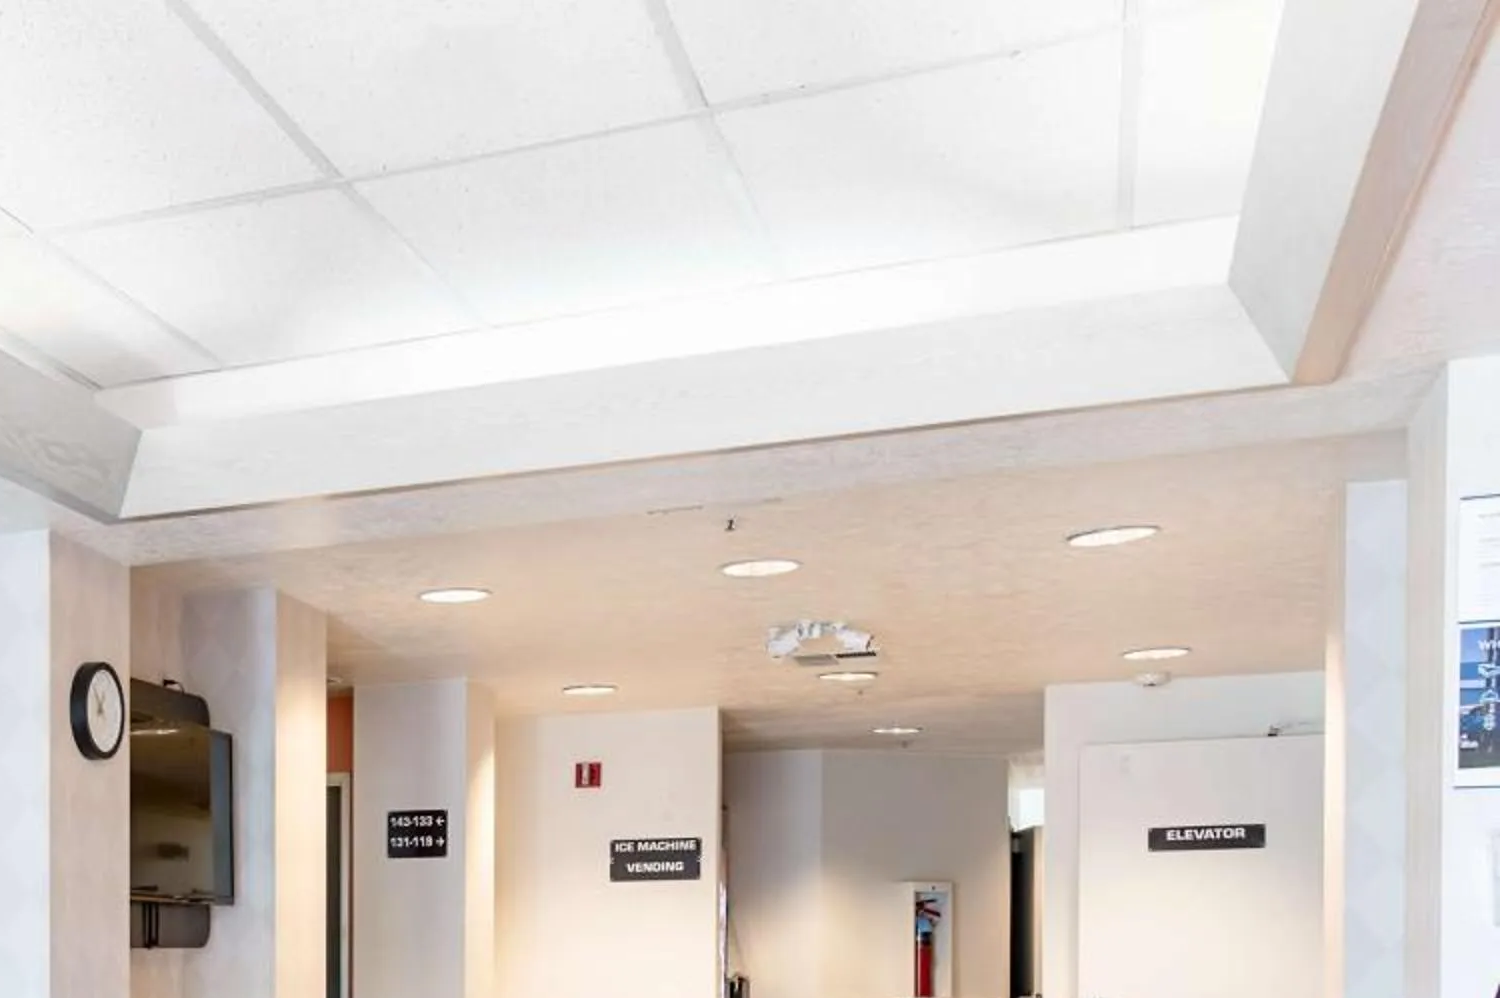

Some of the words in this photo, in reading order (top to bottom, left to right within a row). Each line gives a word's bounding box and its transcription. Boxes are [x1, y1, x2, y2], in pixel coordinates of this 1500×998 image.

[1165, 826, 1247, 841] ELEVATOR
[615, 842, 635, 853] ICE
[637, 839, 697, 852] MACHINE
[626, 861, 685, 873] VENDING
